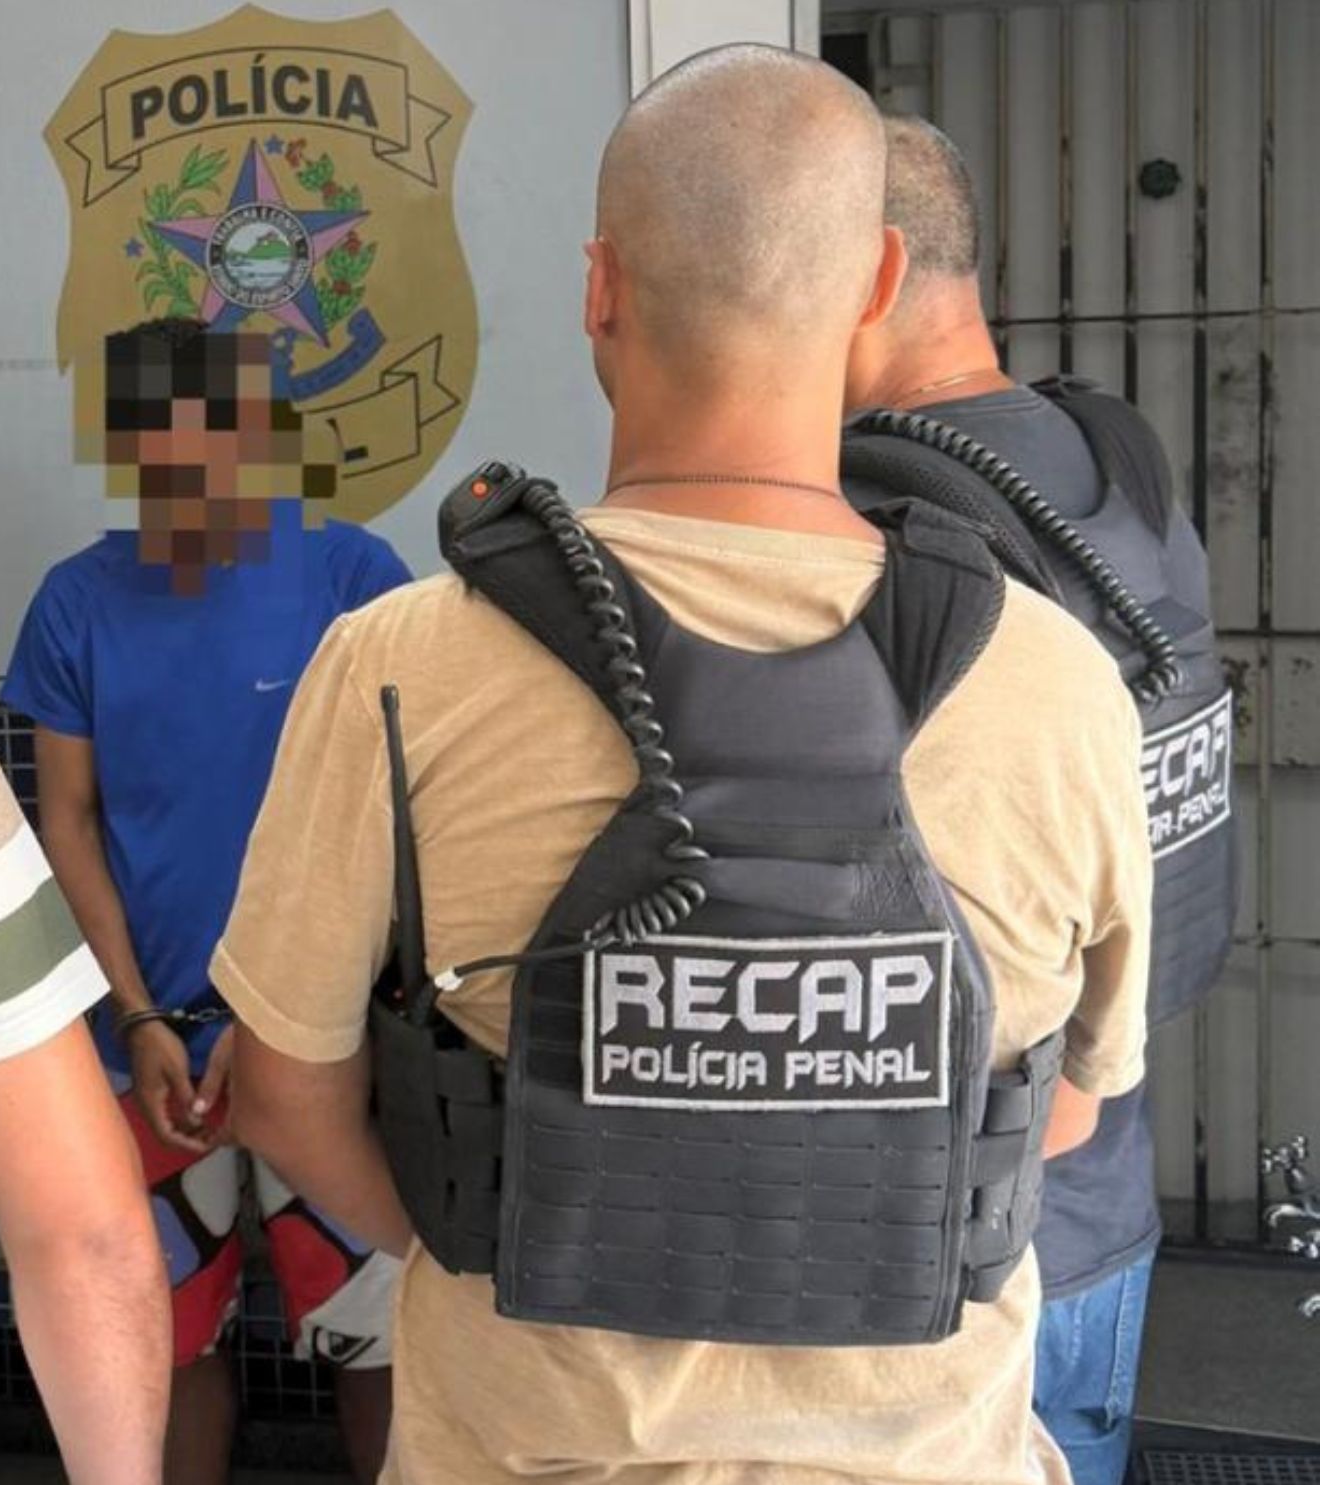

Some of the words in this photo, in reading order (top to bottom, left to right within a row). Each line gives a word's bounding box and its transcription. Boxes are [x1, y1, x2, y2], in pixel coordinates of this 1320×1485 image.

[130, 53, 379, 140] POLÍCIA
[1140, 709, 1228, 804] ECAP
[599, 954, 935, 1045] RECAP
[602, 1041, 768, 1091] POLÍCIA
[784, 1042, 932, 1091] PENAL
